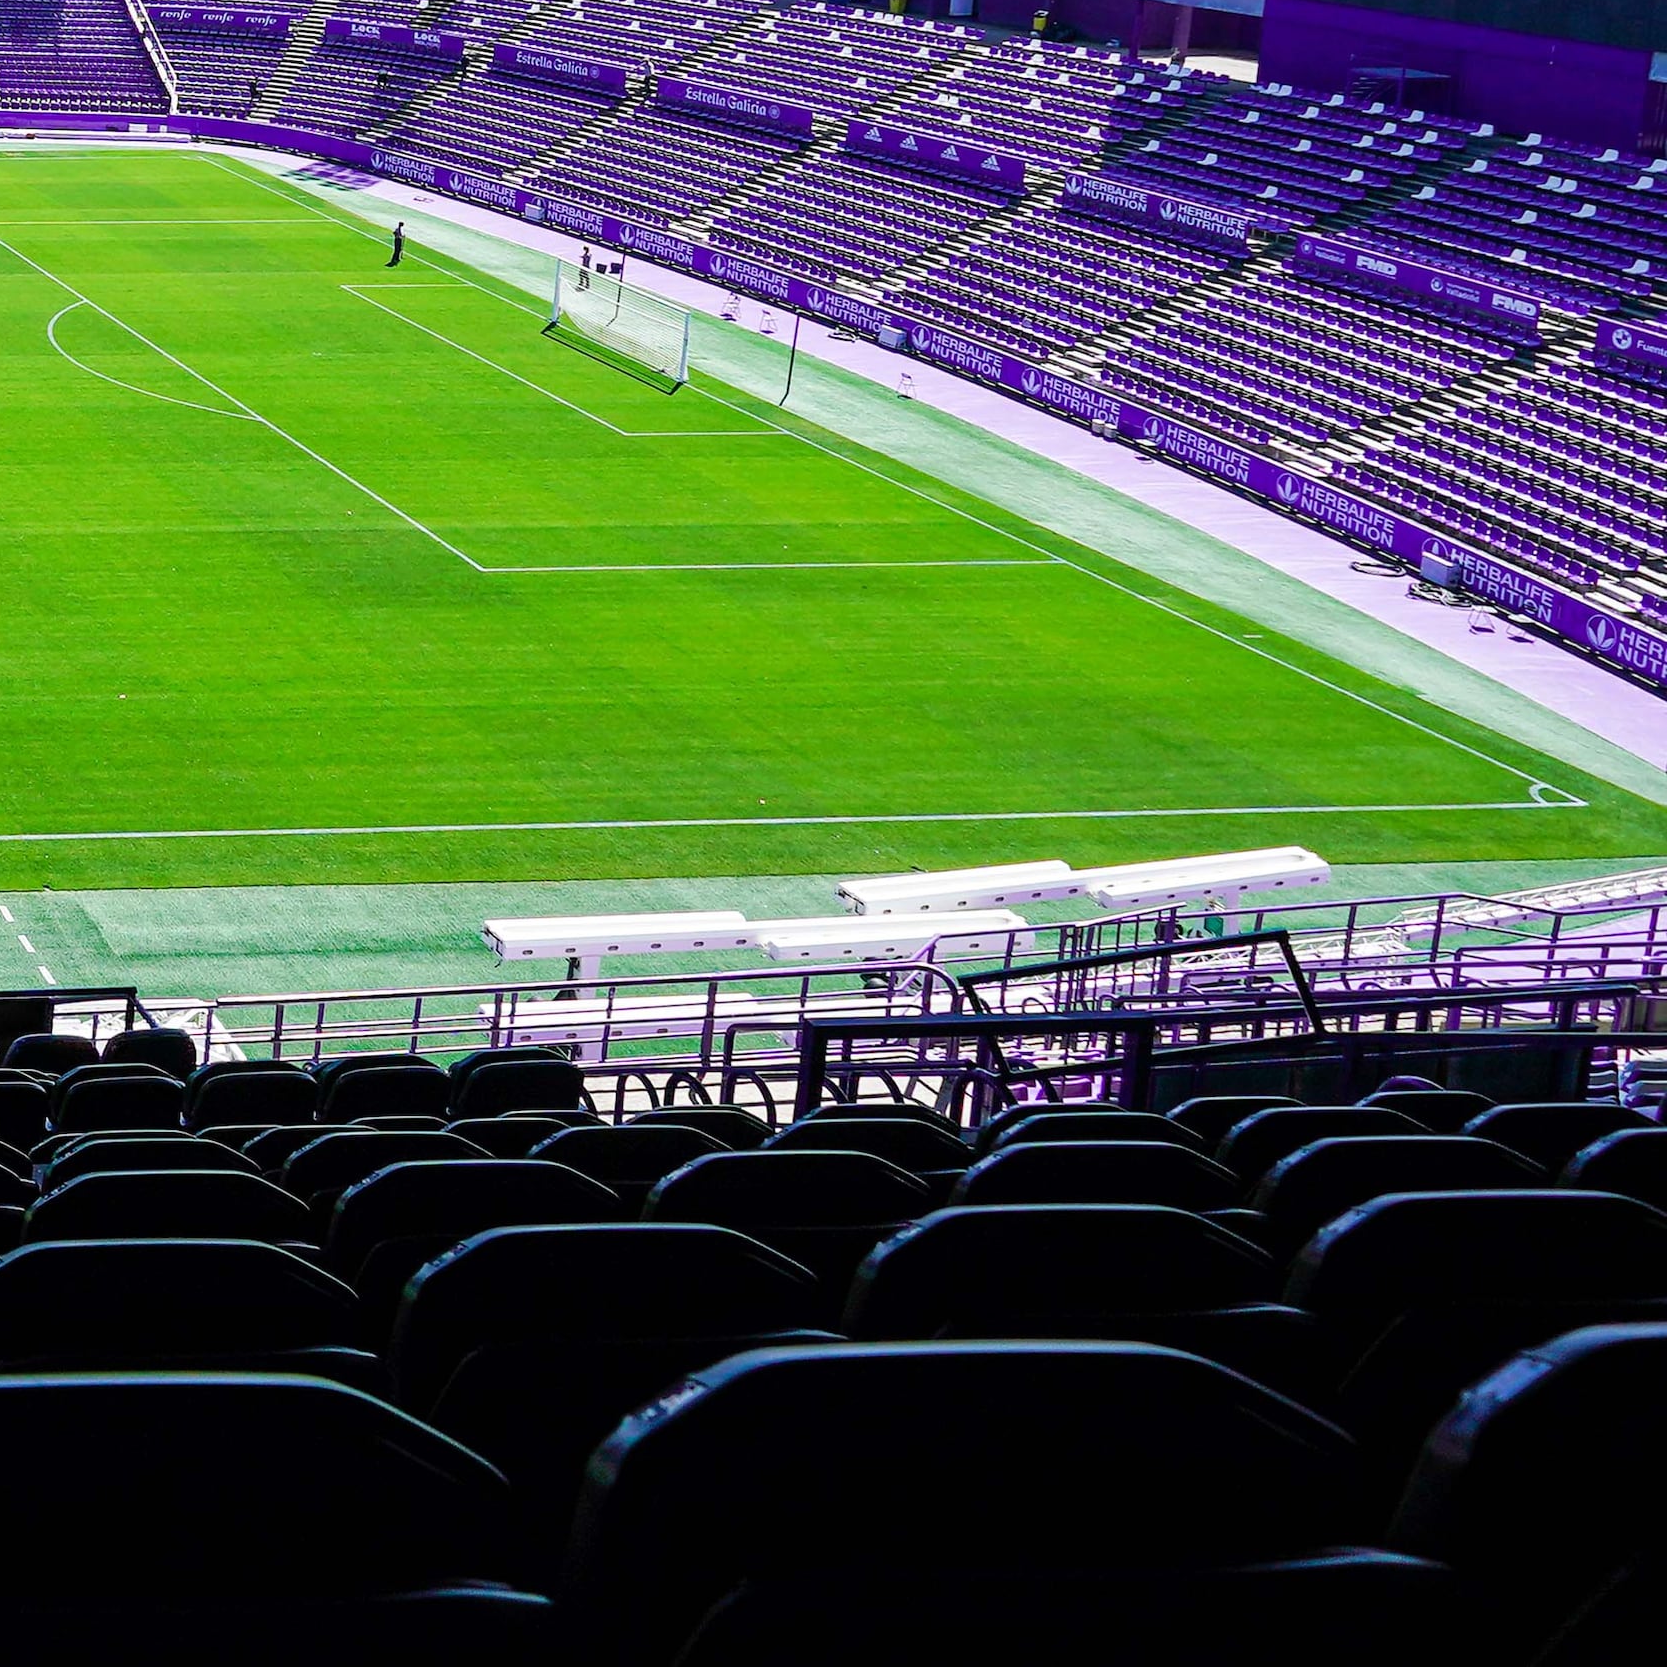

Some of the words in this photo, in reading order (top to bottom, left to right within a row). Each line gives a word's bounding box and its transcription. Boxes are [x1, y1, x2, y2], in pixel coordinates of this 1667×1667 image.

[160, 9, 191, 21] renfe
[203, 12, 234, 24] renfe
[245, 15, 277, 27] renfe
[515, 51, 552, 70] Estrella
[553, 59, 588, 76] Galicia
[685, 86, 726, 107] Estrella
[727, 97, 767, 116] Galicia
[384, 165, 434, 184] NUTRITION
[385, 154, 435, 175] HERBALIFE
[463, 186, 516, 208] NUTRITION
[464, 176, 516, 198] HERBALIFE
[1082, 187, 1147, 213] NUTRITION
[1083, 178, 1147, 203] HERBALIFE
[547, 210, 602, 235] NUTRITION
[548, 200, 603, 226] HERBALIFE
[1177, 213, 1245, 240] NUTRITION
[1178, 204, 1247, 230] HERBALIFE
[634, 238, 693, 265] NUTRITION
[635, 229, 694, 256] HERBALIFE
[726, 269, 788, 299] NUTRITION
[728, 258, 789, 288] HERBALIFE
[824, 304, 882, 332] NUTRITIO
[825, 293, 892, 325] HERBALIFE
[930, 343, 1002, 380] NUTRITION
[931, 331, 1003, 367] HERBALIFE
[1042, 388, 1118, 427] NUTRITION
[1043, 375, 1121, 414] HERBALIFE
[1165, 438, 1249, 484] NUTRITION
[1166, 425, 1251, 470] HERBALIFE
[1302, 482, 1396, 534] HERBALIFE
[1300, 496, 1394, 549] NUTRITION
[1450, 548, 1555, 608] HERBALIFE
[1462, 566, 1553, 624] UTRITION
